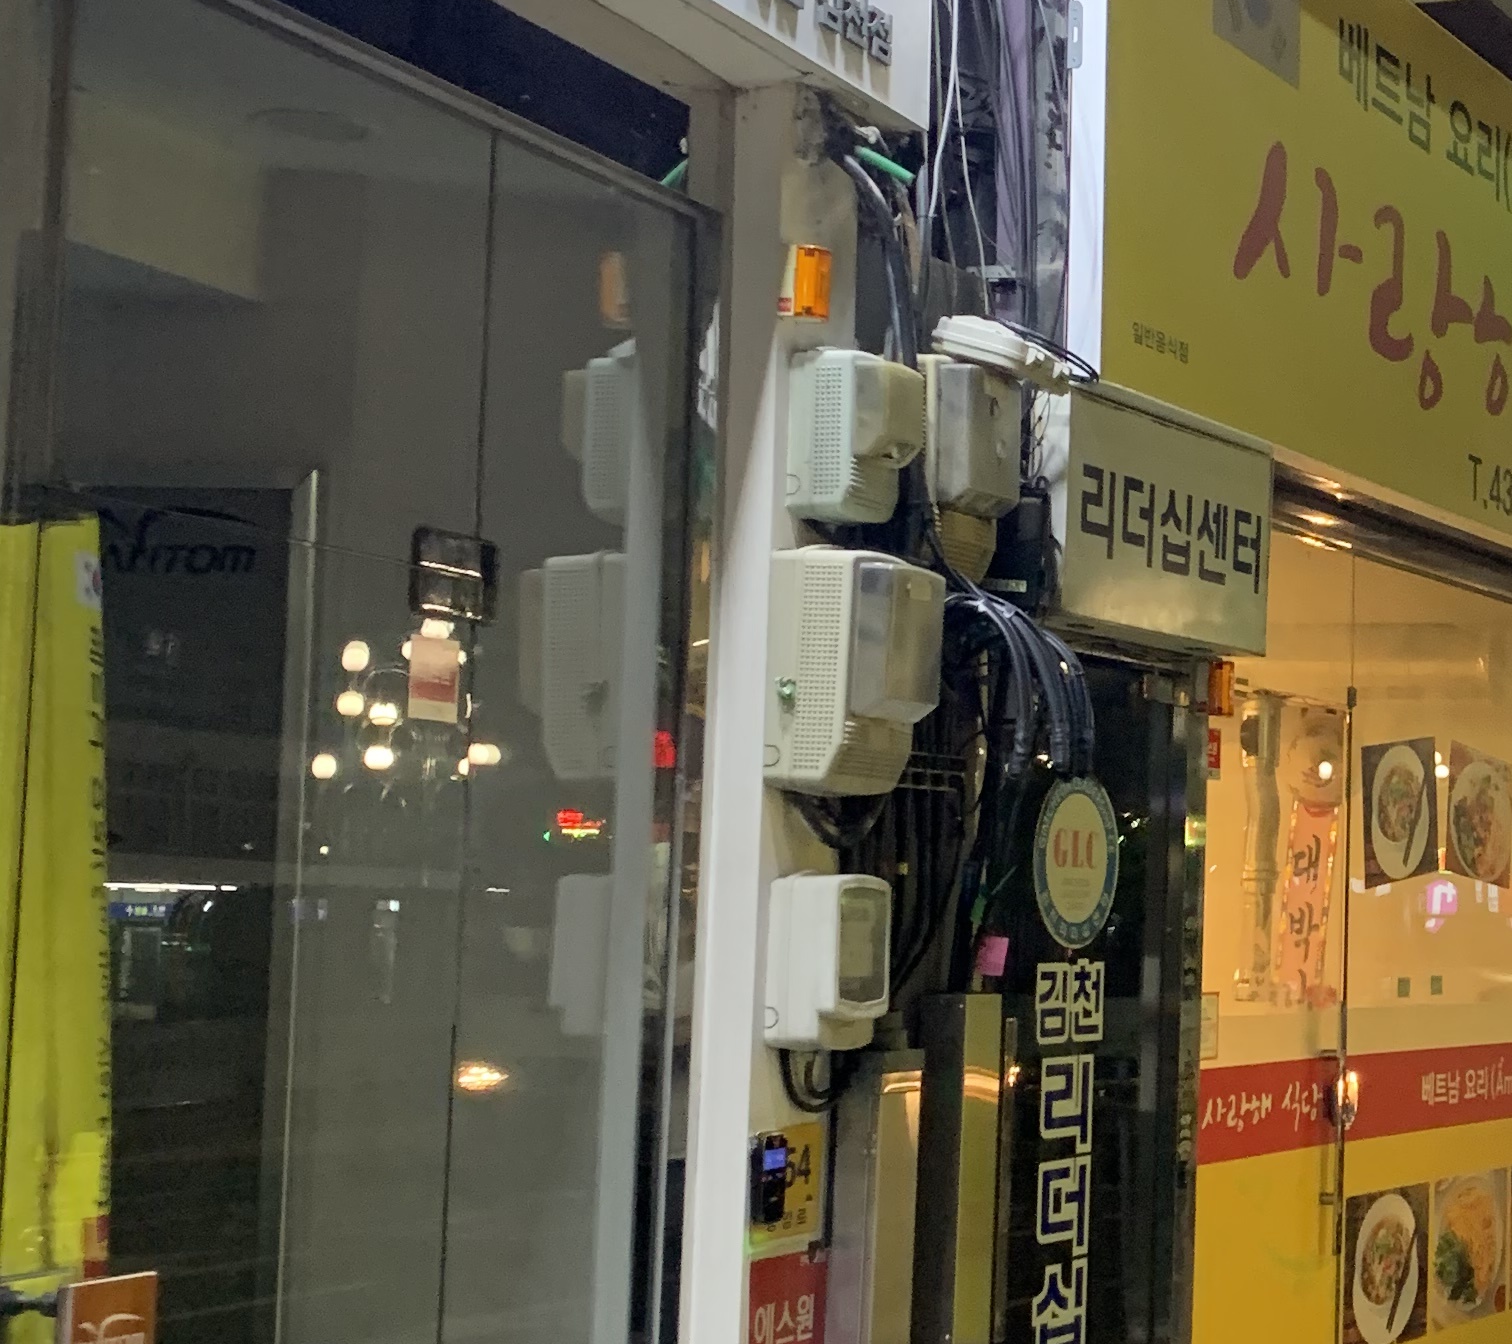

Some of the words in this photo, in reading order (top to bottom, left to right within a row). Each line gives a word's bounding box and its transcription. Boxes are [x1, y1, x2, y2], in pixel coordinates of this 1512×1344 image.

[1338, 17, 1436, 155] 베트남
[1132, 321, 1190, 365] 일반음식점
[1081, 462, 1262, 595] 리더십센터
[1036, 959, 1105, 1043] 김천
[1421, 1071, 1462, 1107] 베트남
